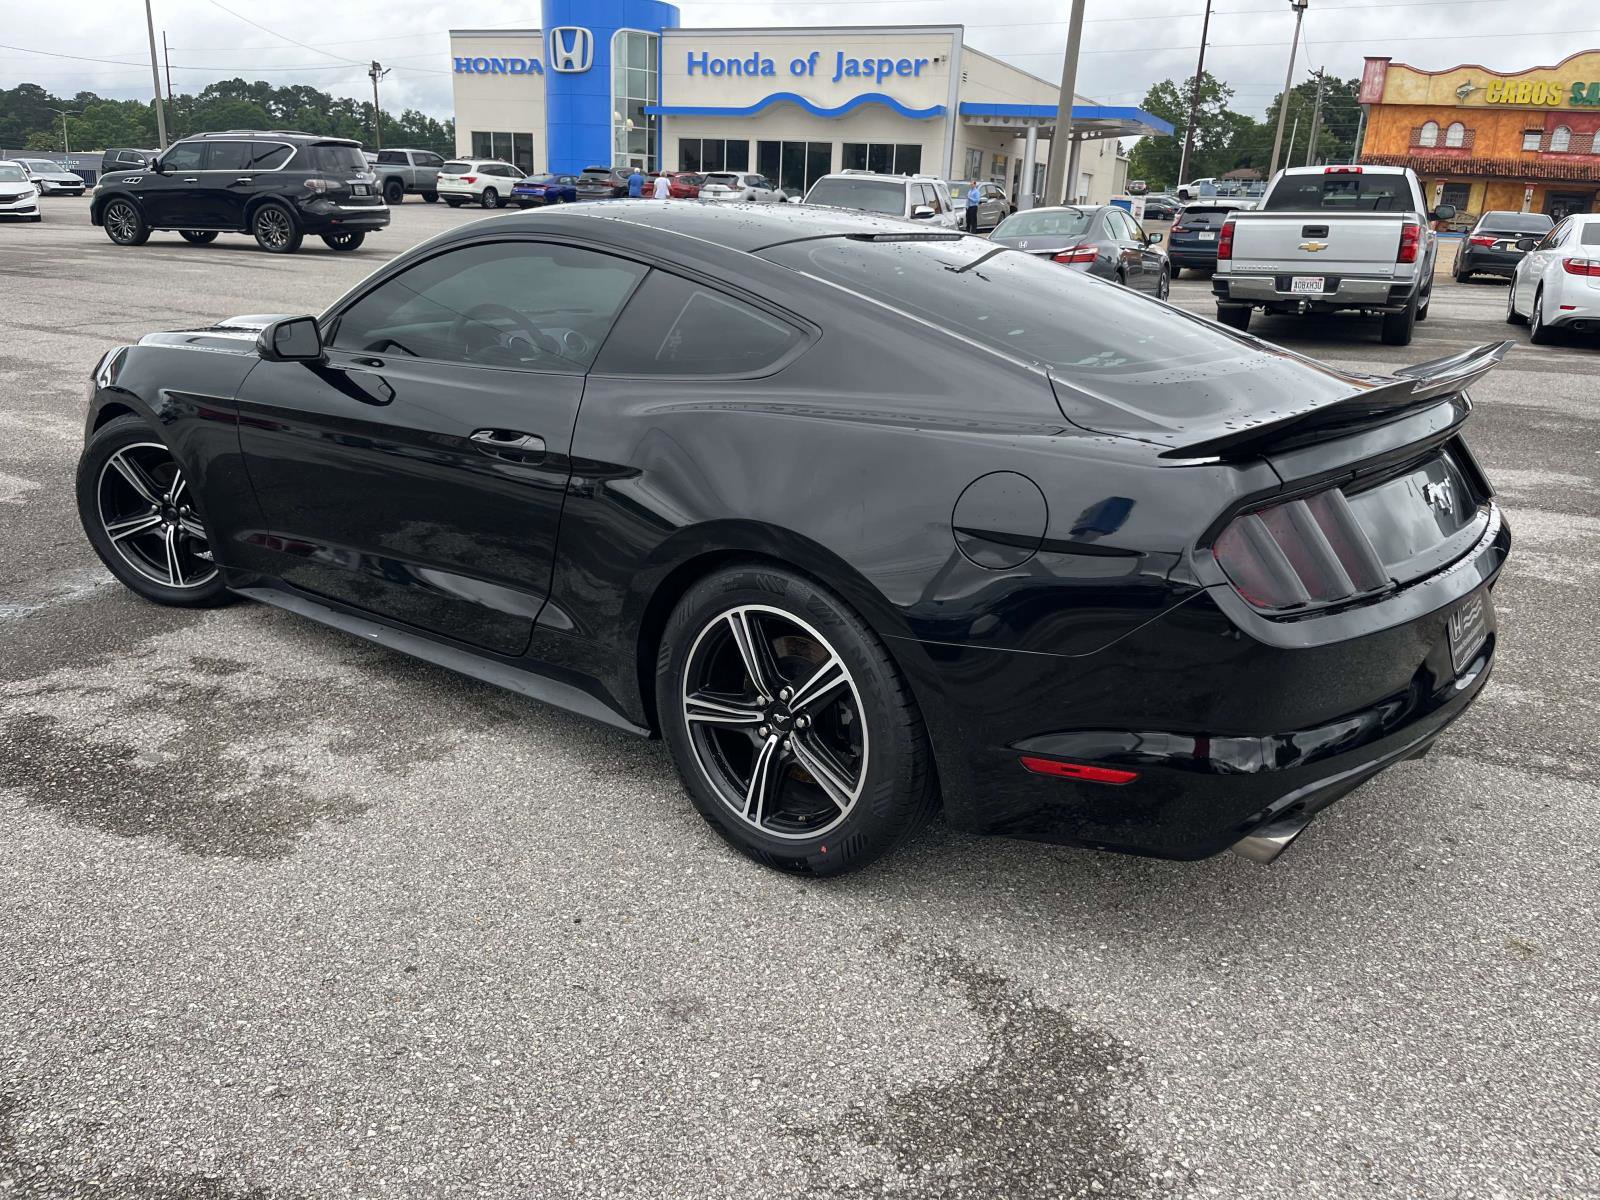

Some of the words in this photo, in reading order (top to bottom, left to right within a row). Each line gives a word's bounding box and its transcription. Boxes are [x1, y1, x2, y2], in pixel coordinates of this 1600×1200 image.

[453, 57, 545, 75] HONDA
[687, 51, 776, 77] Honda
[789, 51, 820, 77] of
[832, 51, 928, 84] Jasper
